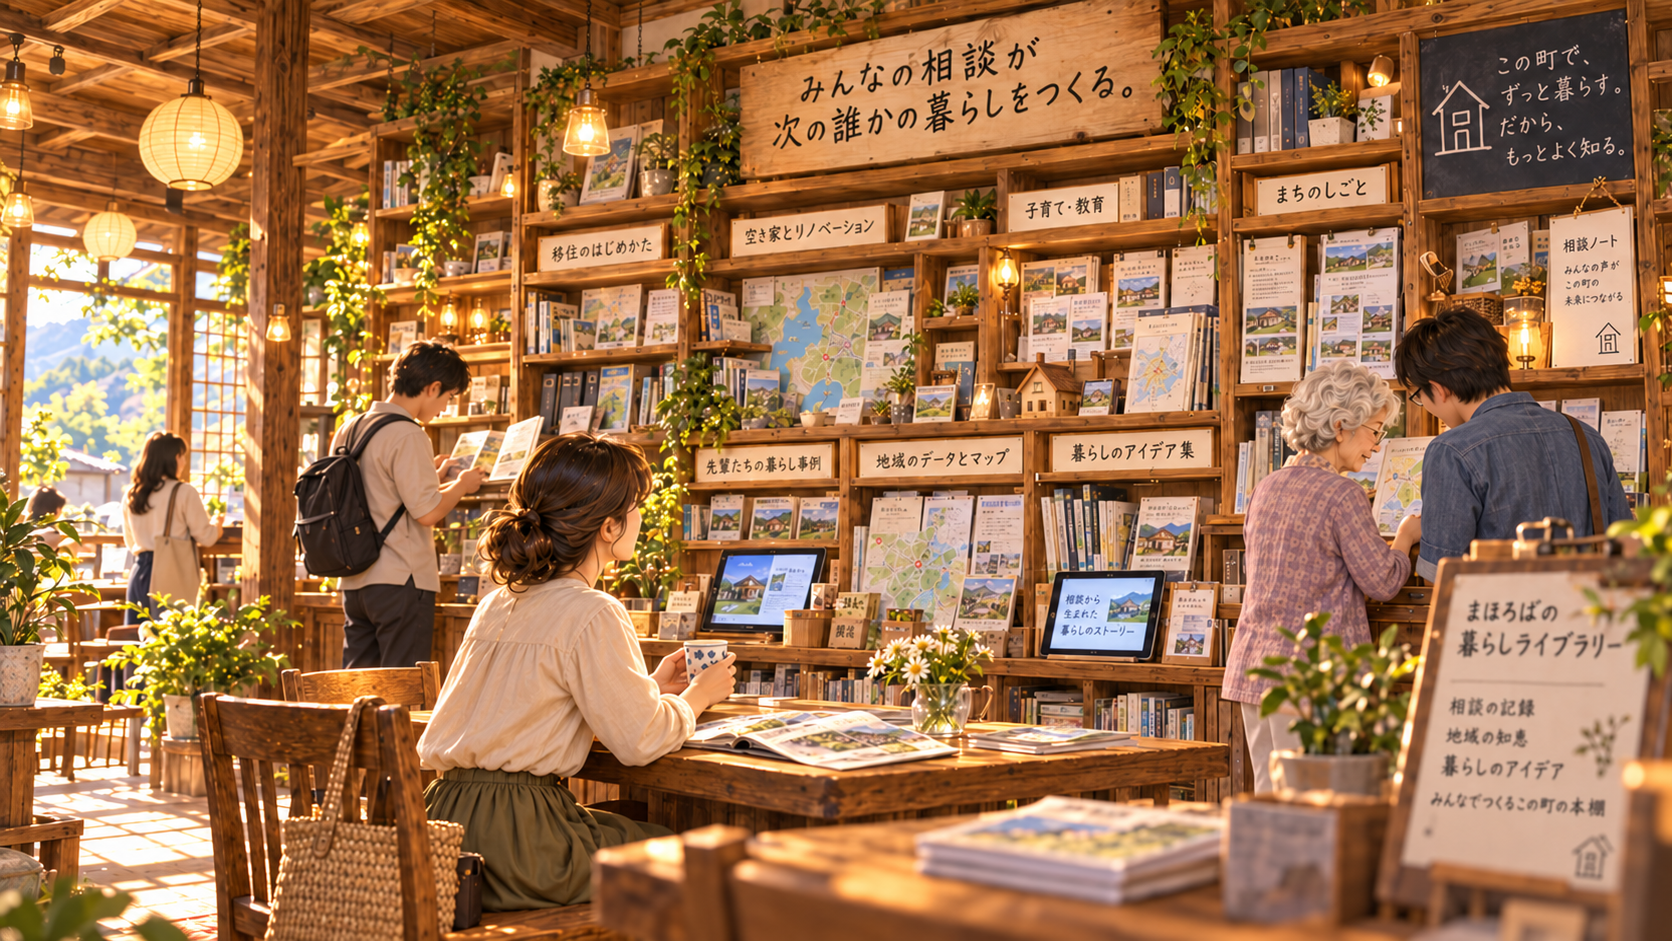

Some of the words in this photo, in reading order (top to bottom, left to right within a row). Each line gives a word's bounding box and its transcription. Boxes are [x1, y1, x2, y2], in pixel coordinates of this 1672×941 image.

[800, 36, 1040, 103] みんなの相談が
[1497, 44, 1590, 75] この町で、
[1501, 73, 1622, 106] ずっと暮らす。
[772, 65, 1133, 150] 次の誰かの暮らしをつくる。
[1500, 112, 1564, 137] だから、
[1506, 136, 1625, 166] もっとよく知る。
[1276, 178, 1367, 204] まちのしごと
[1025, 195, 1105, 220] 子育て・教育
[744, 218, 875, 246] 空き家とリノベーション
[1563, 234, 1618, 254] 相談ノート
[551, 237, 653, 263] 移住のはじめかた
[1564, 259, 1620, 275] みんなの声が
[1565, 279, 1600, 290] この町の
[1564, 291, 1624, 306] 未来につながる
[875, 447, 1010, 469] 地域のデータとマップ
[1070, 440, 1195, 463] 暮らしのアイデア集
[706, 455, 822, 475] 先輩たちの暮らし事例
[1065, 594, 1101, 605] 相談から
[1466, 599, 1559, 624] まほろばの
[1063, 609, 1098, 620] 生まれた
[1061, 624, 1135, 637] 暮らしのストーリー
[1457, 629, 1623, 659] 暮らしライブラリー
[1449, 697, 1536, 718] 相談の記録
[1445, 727, 1529, 748] 地域の知恵
[1440, 754, 1564, 781] 暮らしのアイデア
[1430, 791, 1607, 817] みんなでつくるこの町の本棚
